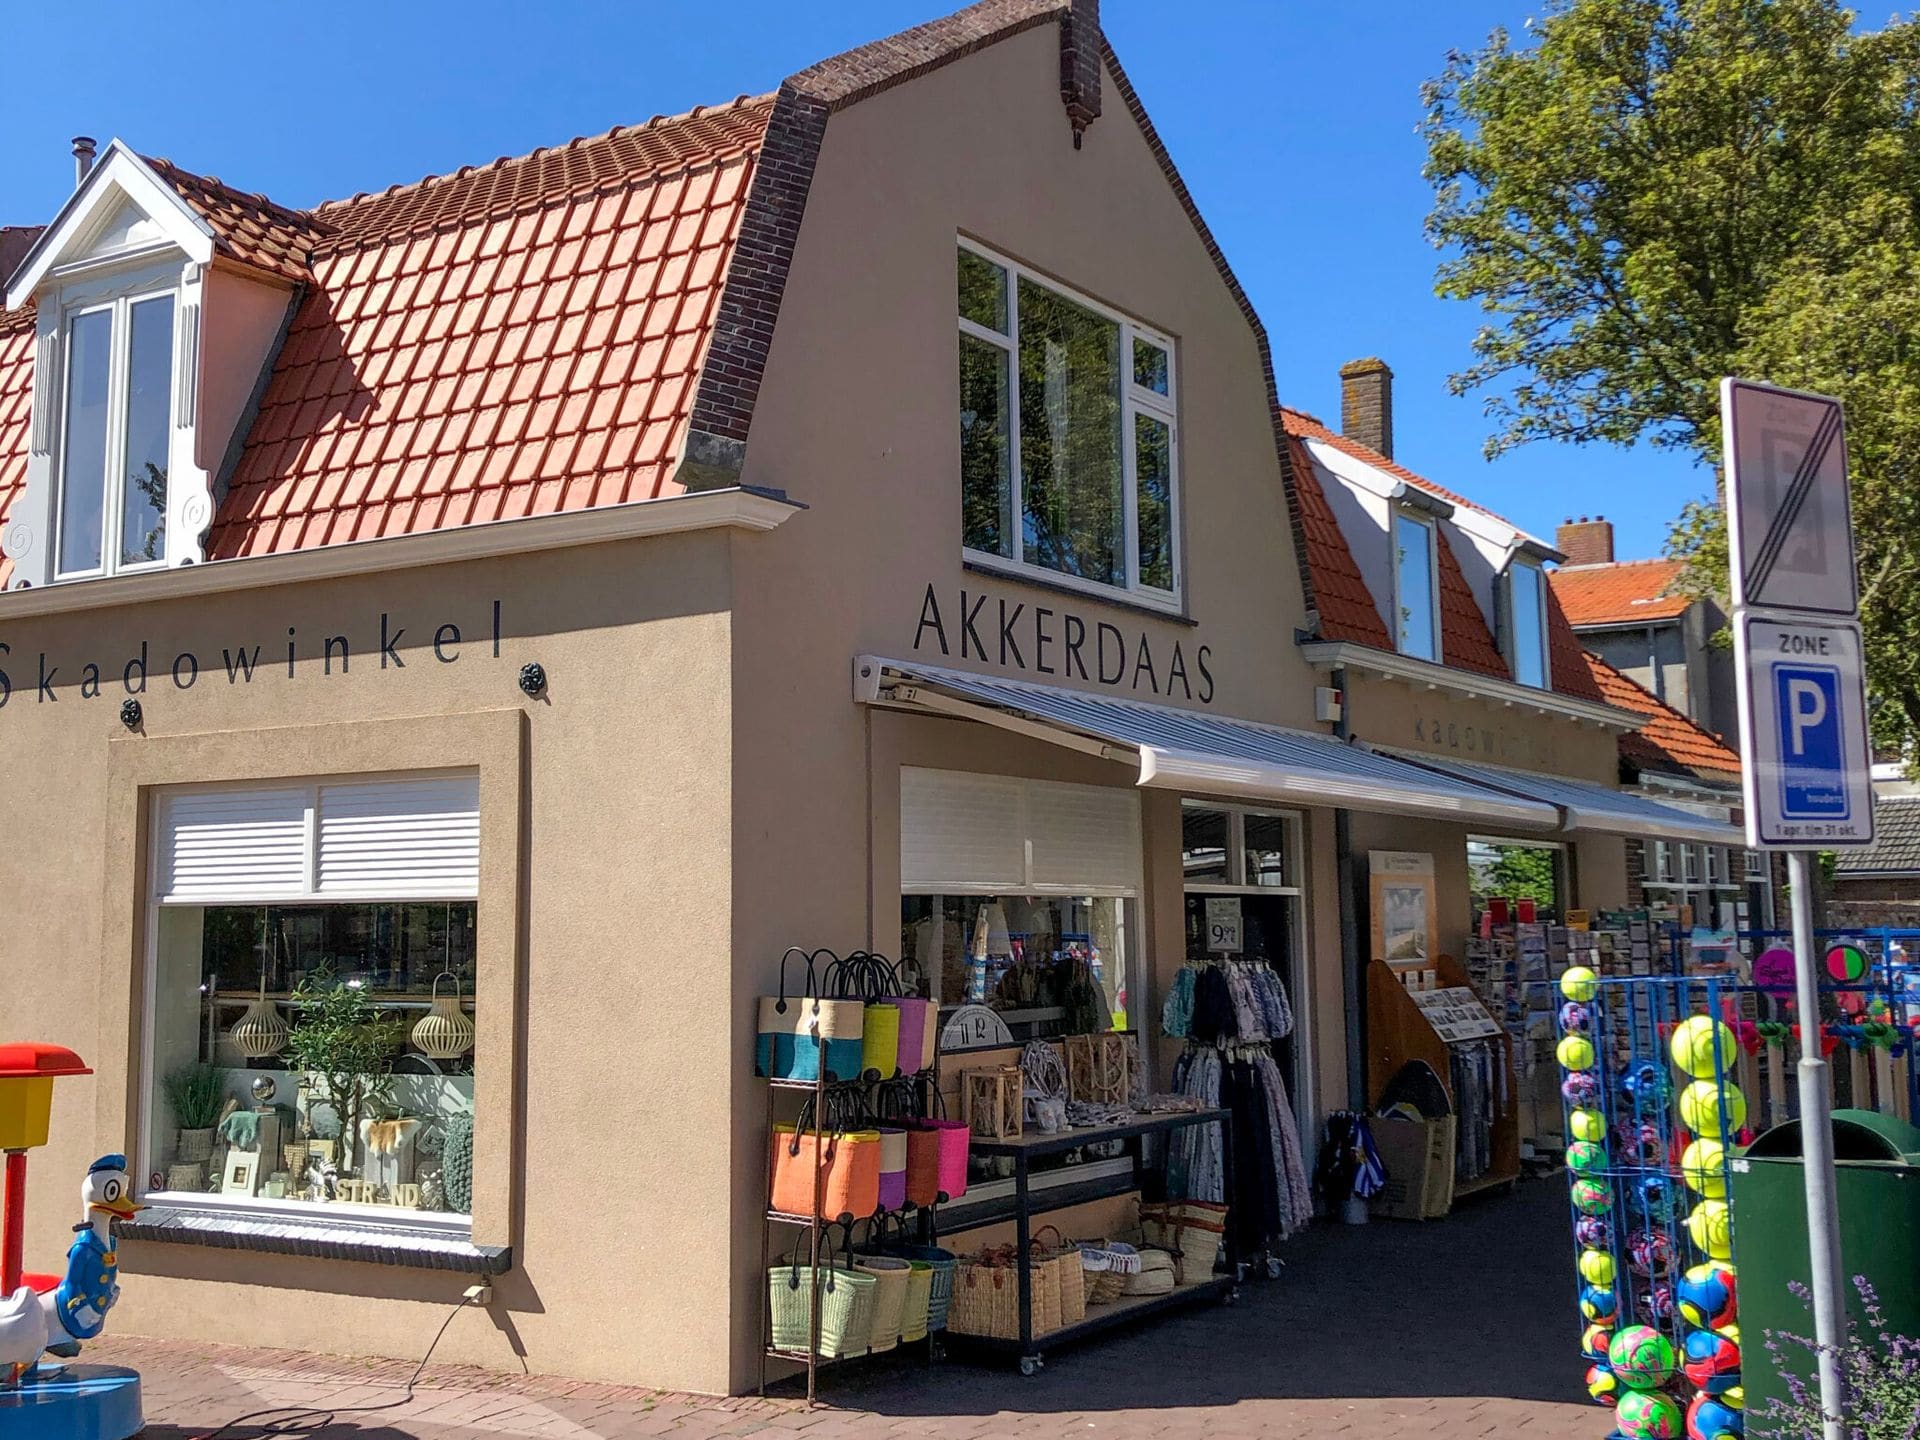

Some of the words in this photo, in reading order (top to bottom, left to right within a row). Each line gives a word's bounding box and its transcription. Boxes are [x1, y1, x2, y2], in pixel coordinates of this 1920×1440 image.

[913, 582, 1214, 704] AKKERDAAS
[1778, 633, 1830, 656] ZONE
[1787, 678, 1827, 756] P
